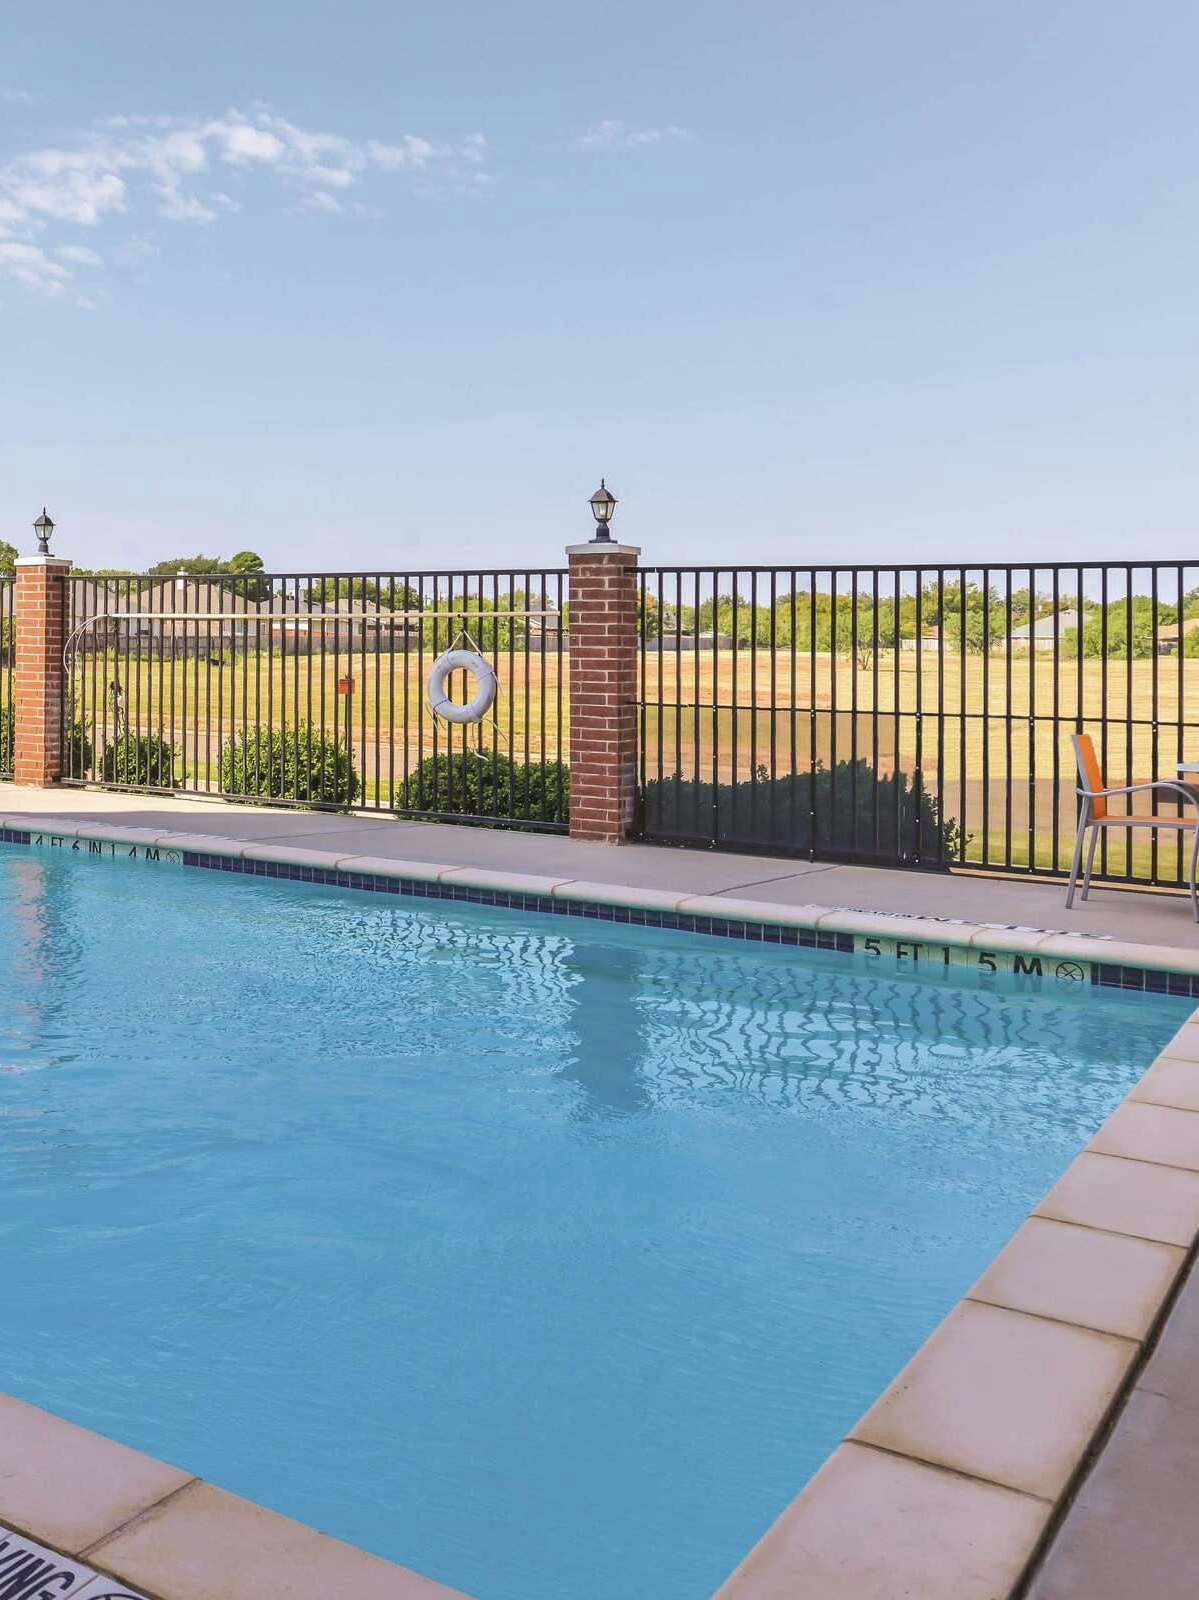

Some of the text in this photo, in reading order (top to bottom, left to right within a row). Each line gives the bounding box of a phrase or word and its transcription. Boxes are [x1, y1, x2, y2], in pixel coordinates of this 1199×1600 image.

[89, 841, 102, 853] IN
[145, 847, 161, 861] M
[864, 938, 881, 956] 5
[896, 941, 923, 961] FT
[978, 952, 997, 971] 5
[1013, 955, 1043, 977] M
